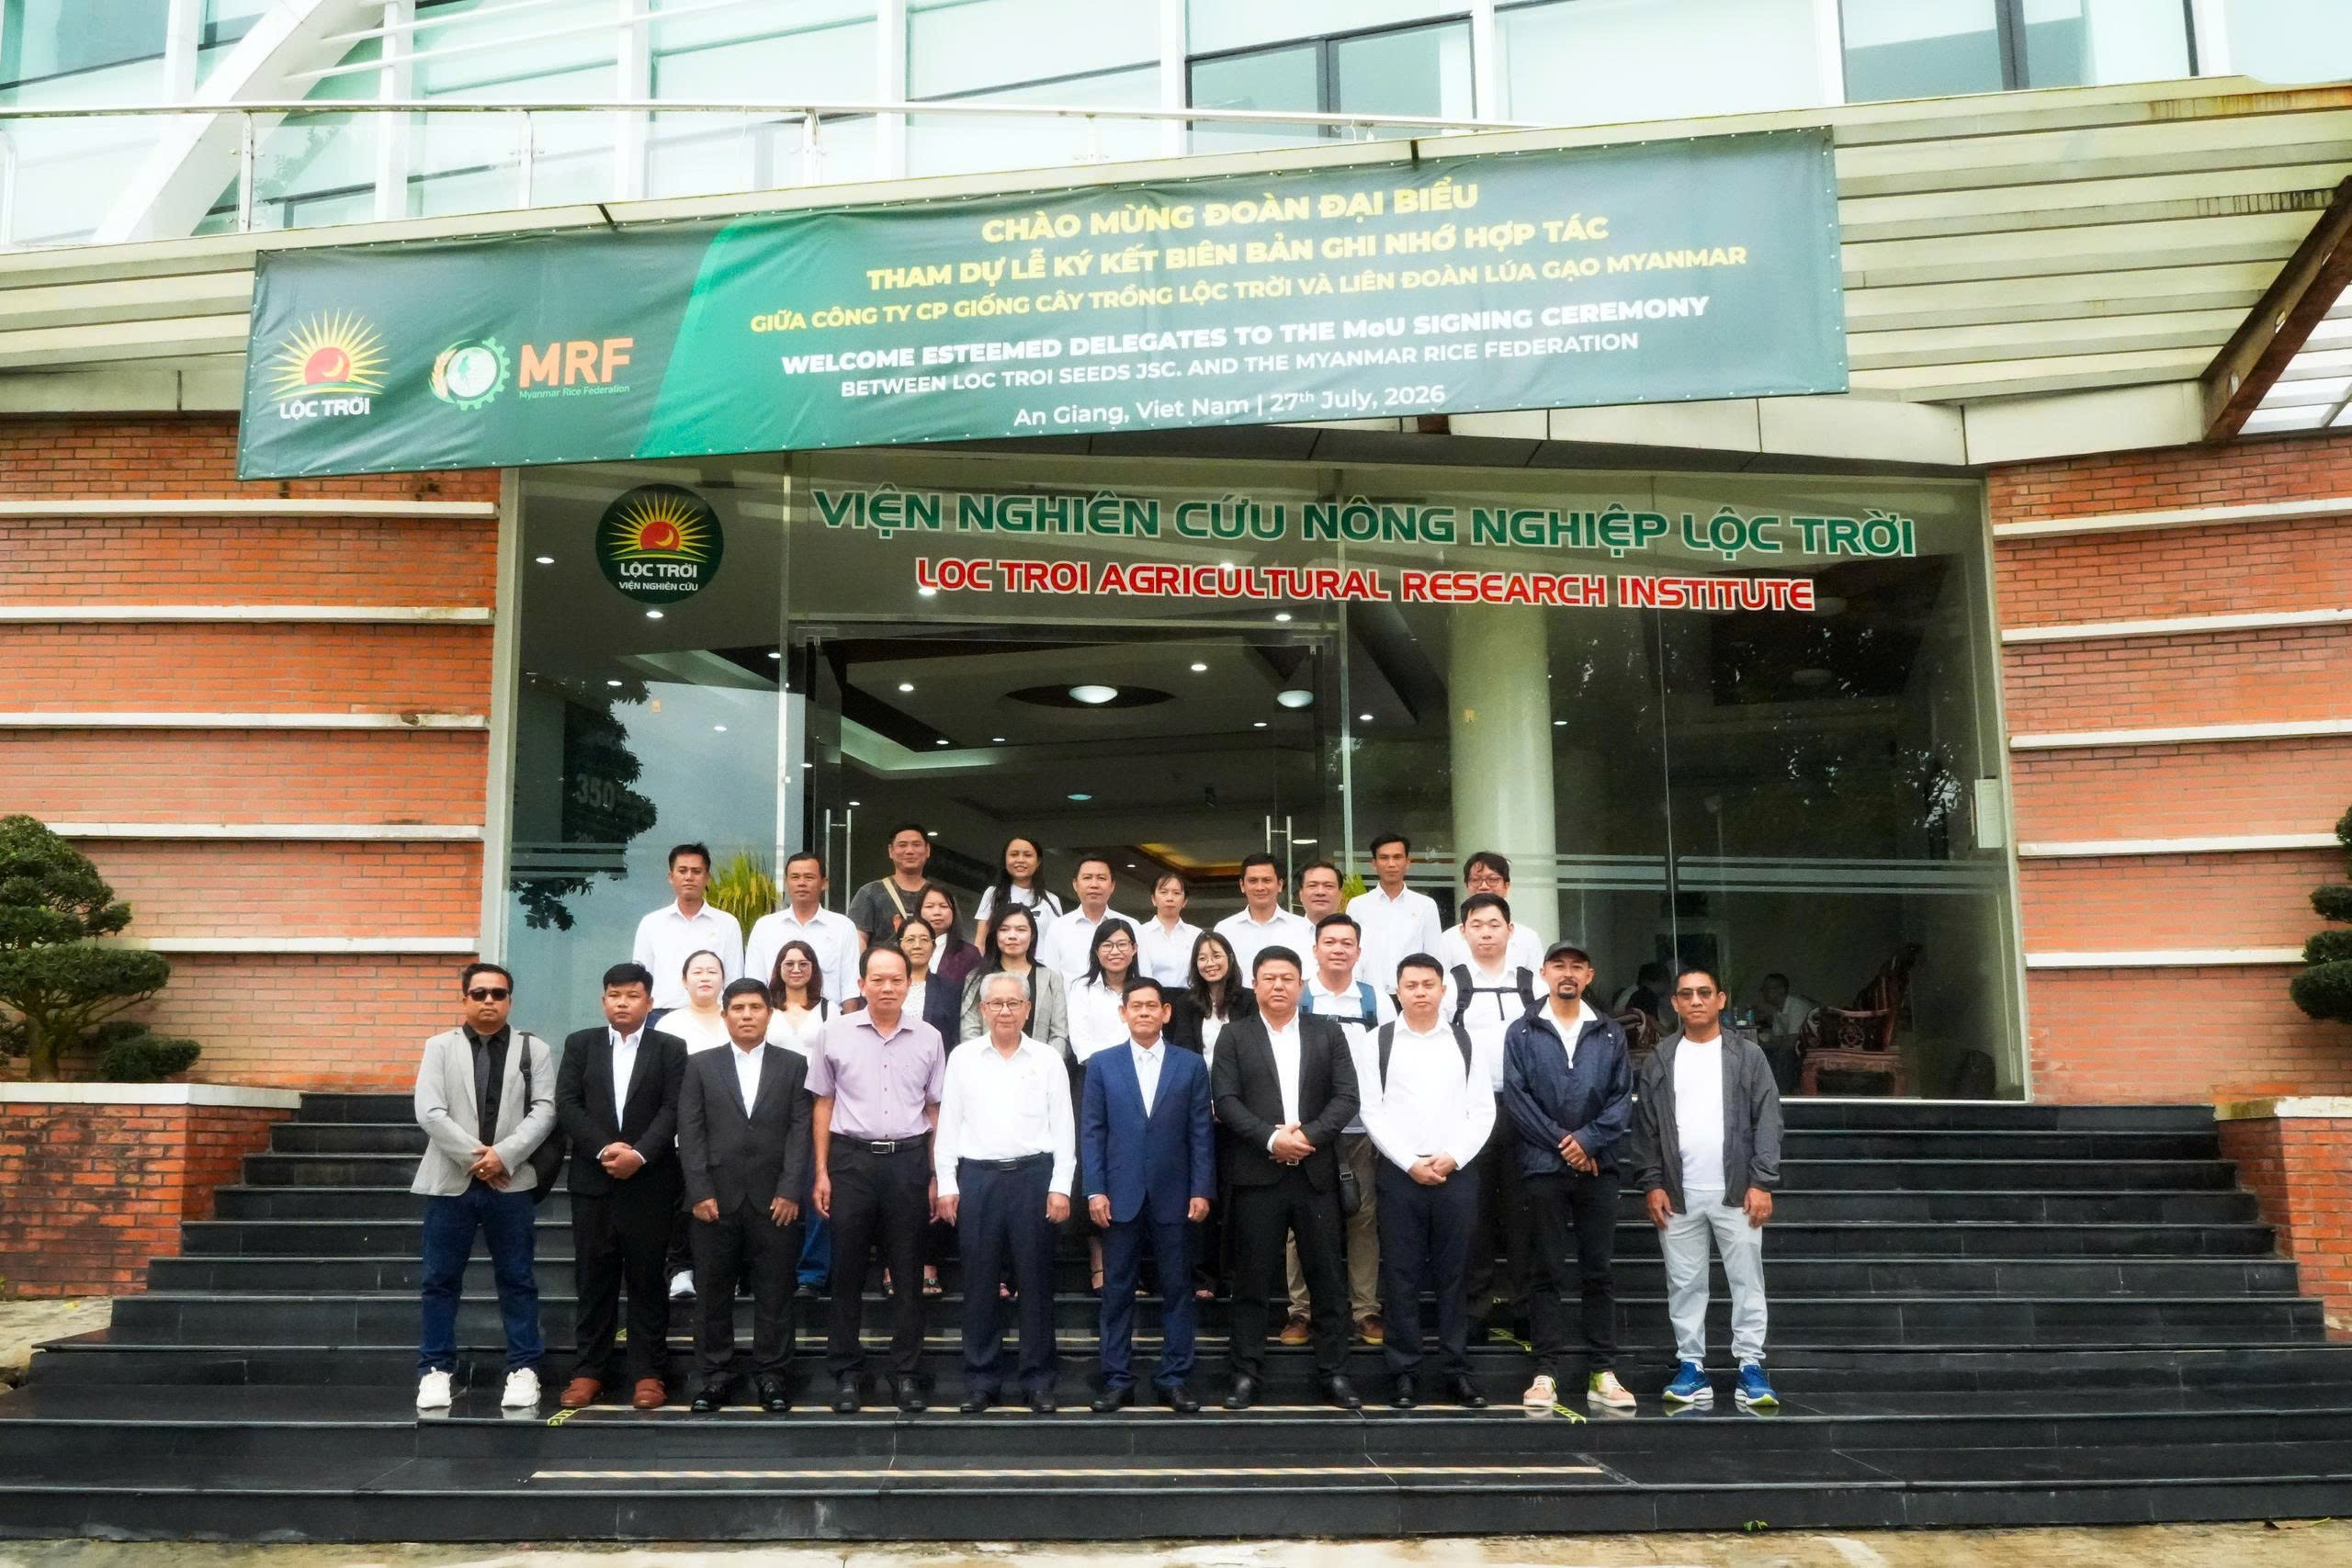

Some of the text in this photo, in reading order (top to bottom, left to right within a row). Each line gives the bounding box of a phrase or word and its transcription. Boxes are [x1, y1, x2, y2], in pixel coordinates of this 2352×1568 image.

[982, 177, 1478, 243] CHÀO MỪNG ĐOÀN ĐẠI BIỂU
[867, 214, 1610, 290] THAM DỰ LỄ KÝ KẾT BIÊN BẢN GHI NHỚ HỢP TÁC
[751, 246, 1747, 333] GIỮA CÔNG TY CP GIỐNG CÂY TRỒNG LỘC TRỜI VÀ LIÊN ĐOÀN LÚA GẠO MYANMAR
[519, 337, 633, 389] MRF
[781, 296, 1710, 375] WELCOME ESTEEMED DELEGATES TO THE MoU SIGNING CEREMONY
[519, 384, 630, 400] Myanmar Rice Federation
[841, 333, 1639, 397] BETWEEN LOC TROI SEEDS JSC. AND THE MYANMAR RICE FEDERATION
[280, 396, 370, 421] LỘC TRỜI
[1013, 408, 1046, 427] An
[1054, 403, 1130, 424] Giang,
[1136, 399, 1184, 420] Viet
[1192, 396, 1249, 417] Nam
[1270, 391, 1316, 412] 27th
[1321, 387, 1378, 412] July,
[1385, 384, 1445, 406] 2026
[810, 481, 1917, 561] VIỆN NGHIÊN CỨU NÔNG NGHIỆP LỘC TRỜI
[618, 580, 698, 592] VIỆN NGHIÊN CỨU
[620, 561, 697, 578] LỘC TRỜI
[916, 556, 1815, 612] LOC TROI AGRICULTURAL RESEARCH INSTITUTE
